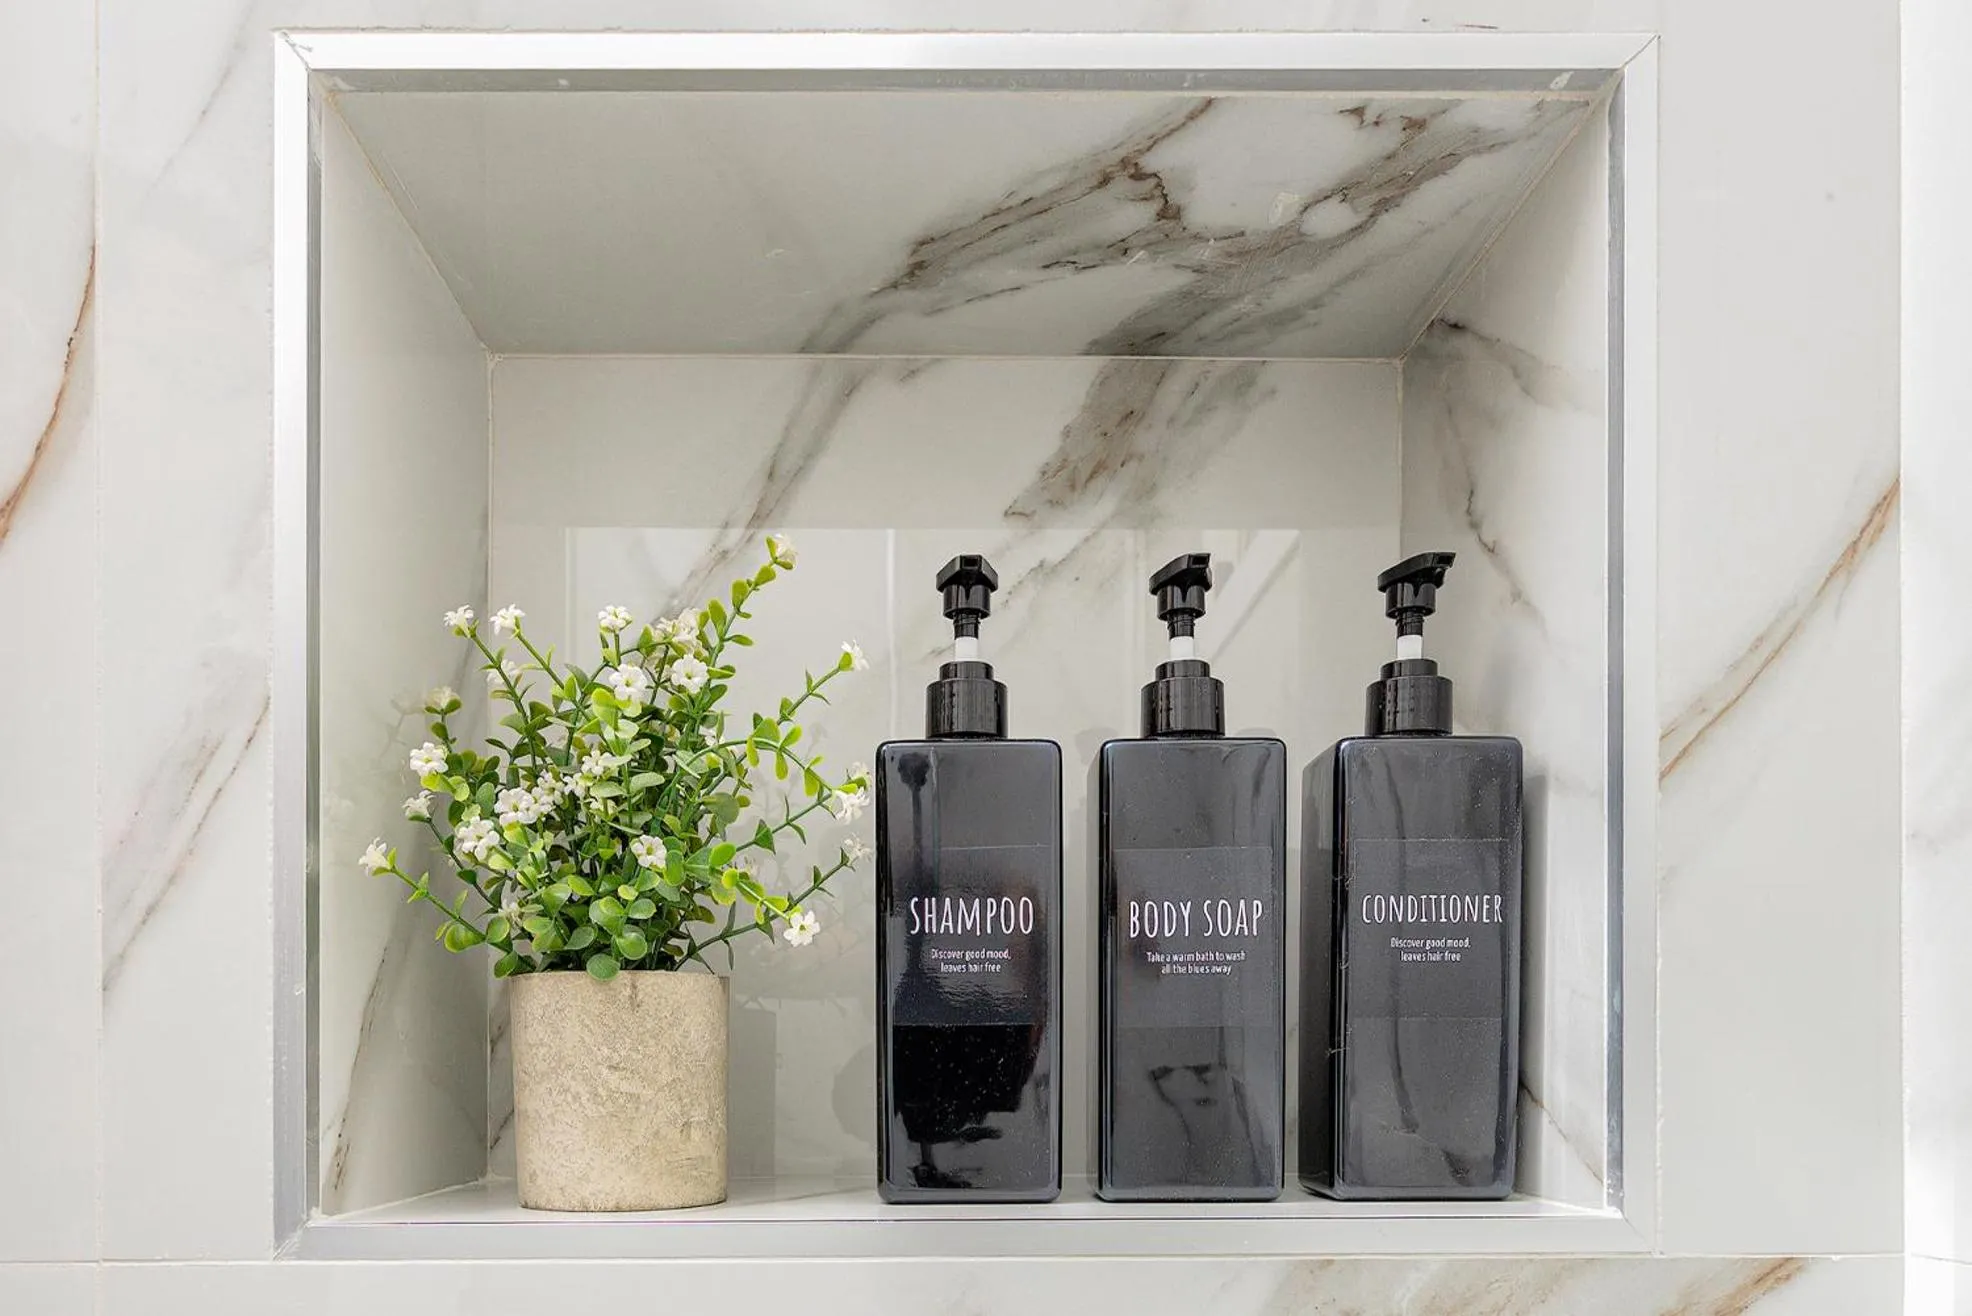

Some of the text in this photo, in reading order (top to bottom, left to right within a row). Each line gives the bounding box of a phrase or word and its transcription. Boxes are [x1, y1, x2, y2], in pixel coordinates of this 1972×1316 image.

[1362, 894, 1503, 924] CONDITIONER
[910, 896, 1034, 936] SHAMPOO
[1130, 899, 1263, 938] BODY SOAP
[1390, 937, 1424, 948] Discover
[1425, 937, 1445, 950] good
[931, 948, 964, 959] Discover
[965, 948, 985, 961] good
[1146, 951, 1165, 962] Take
[1172, 953, 1195, 962] warm
[1195, 951, 1215, 961] bath
[1225, 950, 1246, 961] wash
[1400, 951, 1462, 962] leaves hair free
[940, 961, 1001, 973] leaves hair free
[1161, 963, 1231, 976] all the blues away
